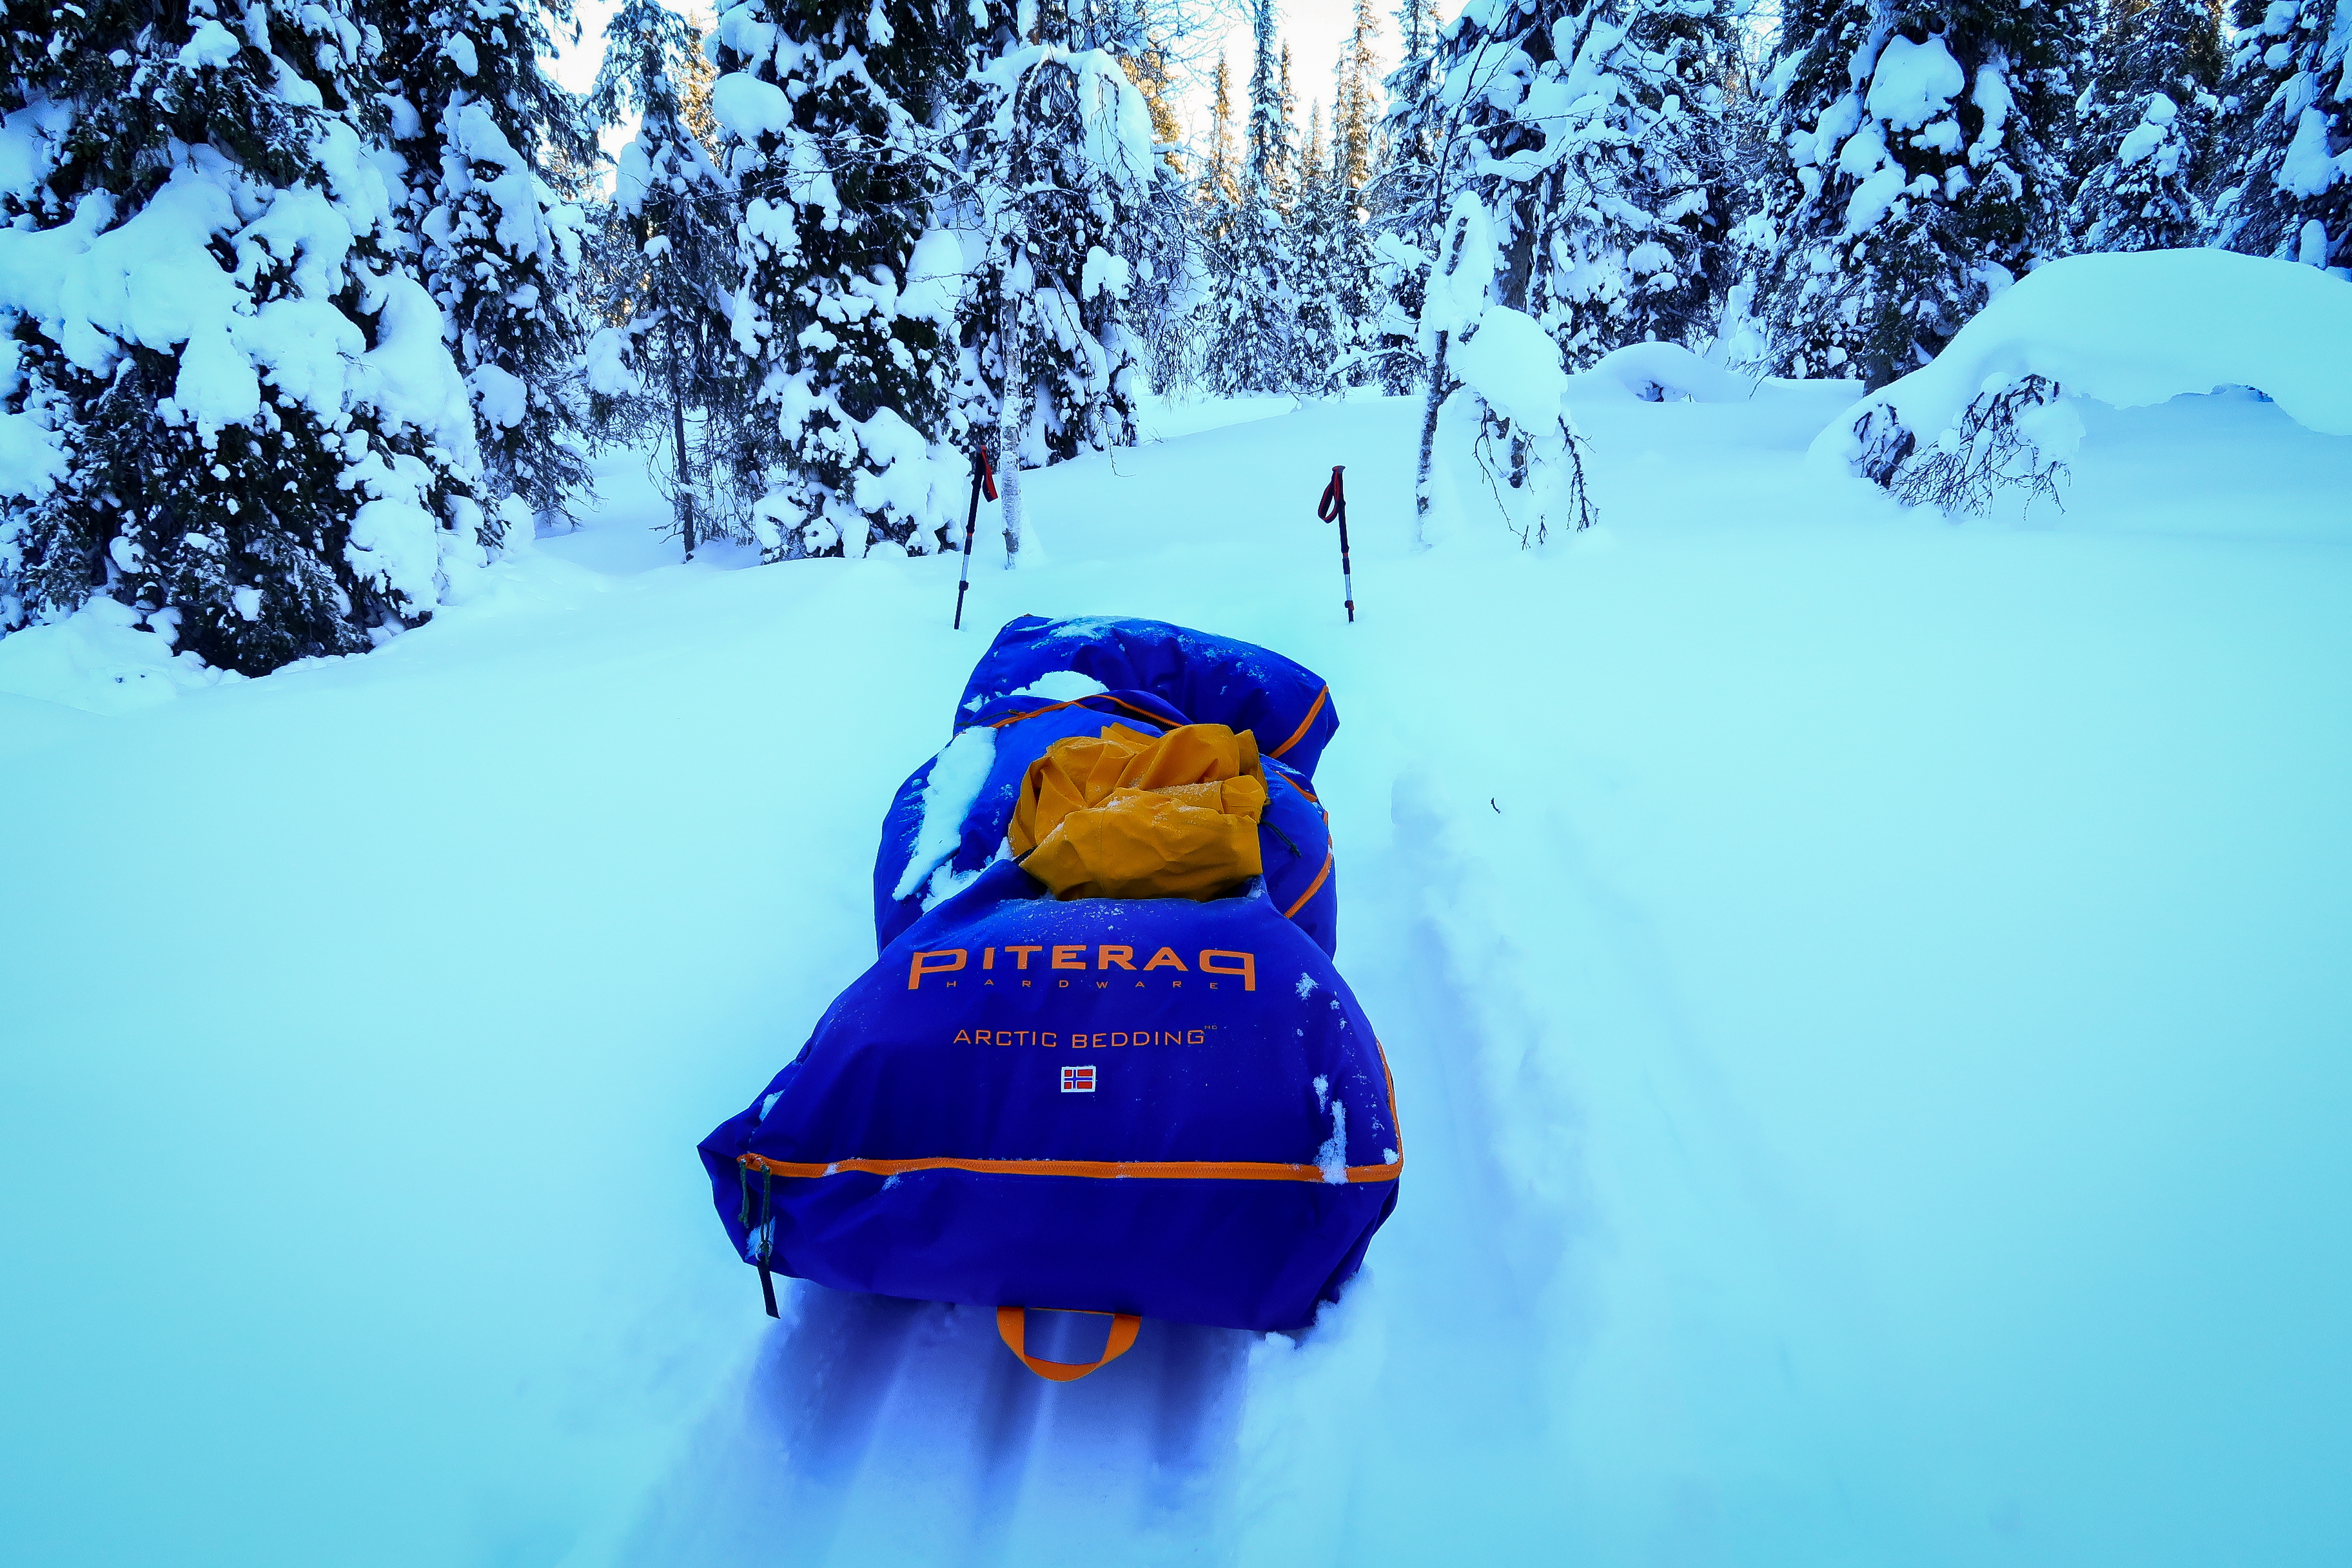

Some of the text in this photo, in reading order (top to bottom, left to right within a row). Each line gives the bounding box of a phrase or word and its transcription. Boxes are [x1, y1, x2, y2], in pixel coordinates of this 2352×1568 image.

[946, 979, 1219, 989] HARDWARE
[953, 1030, 1057, 1048] ARCTIC
[1072, 1030, 1204, 1048] BEDDING
